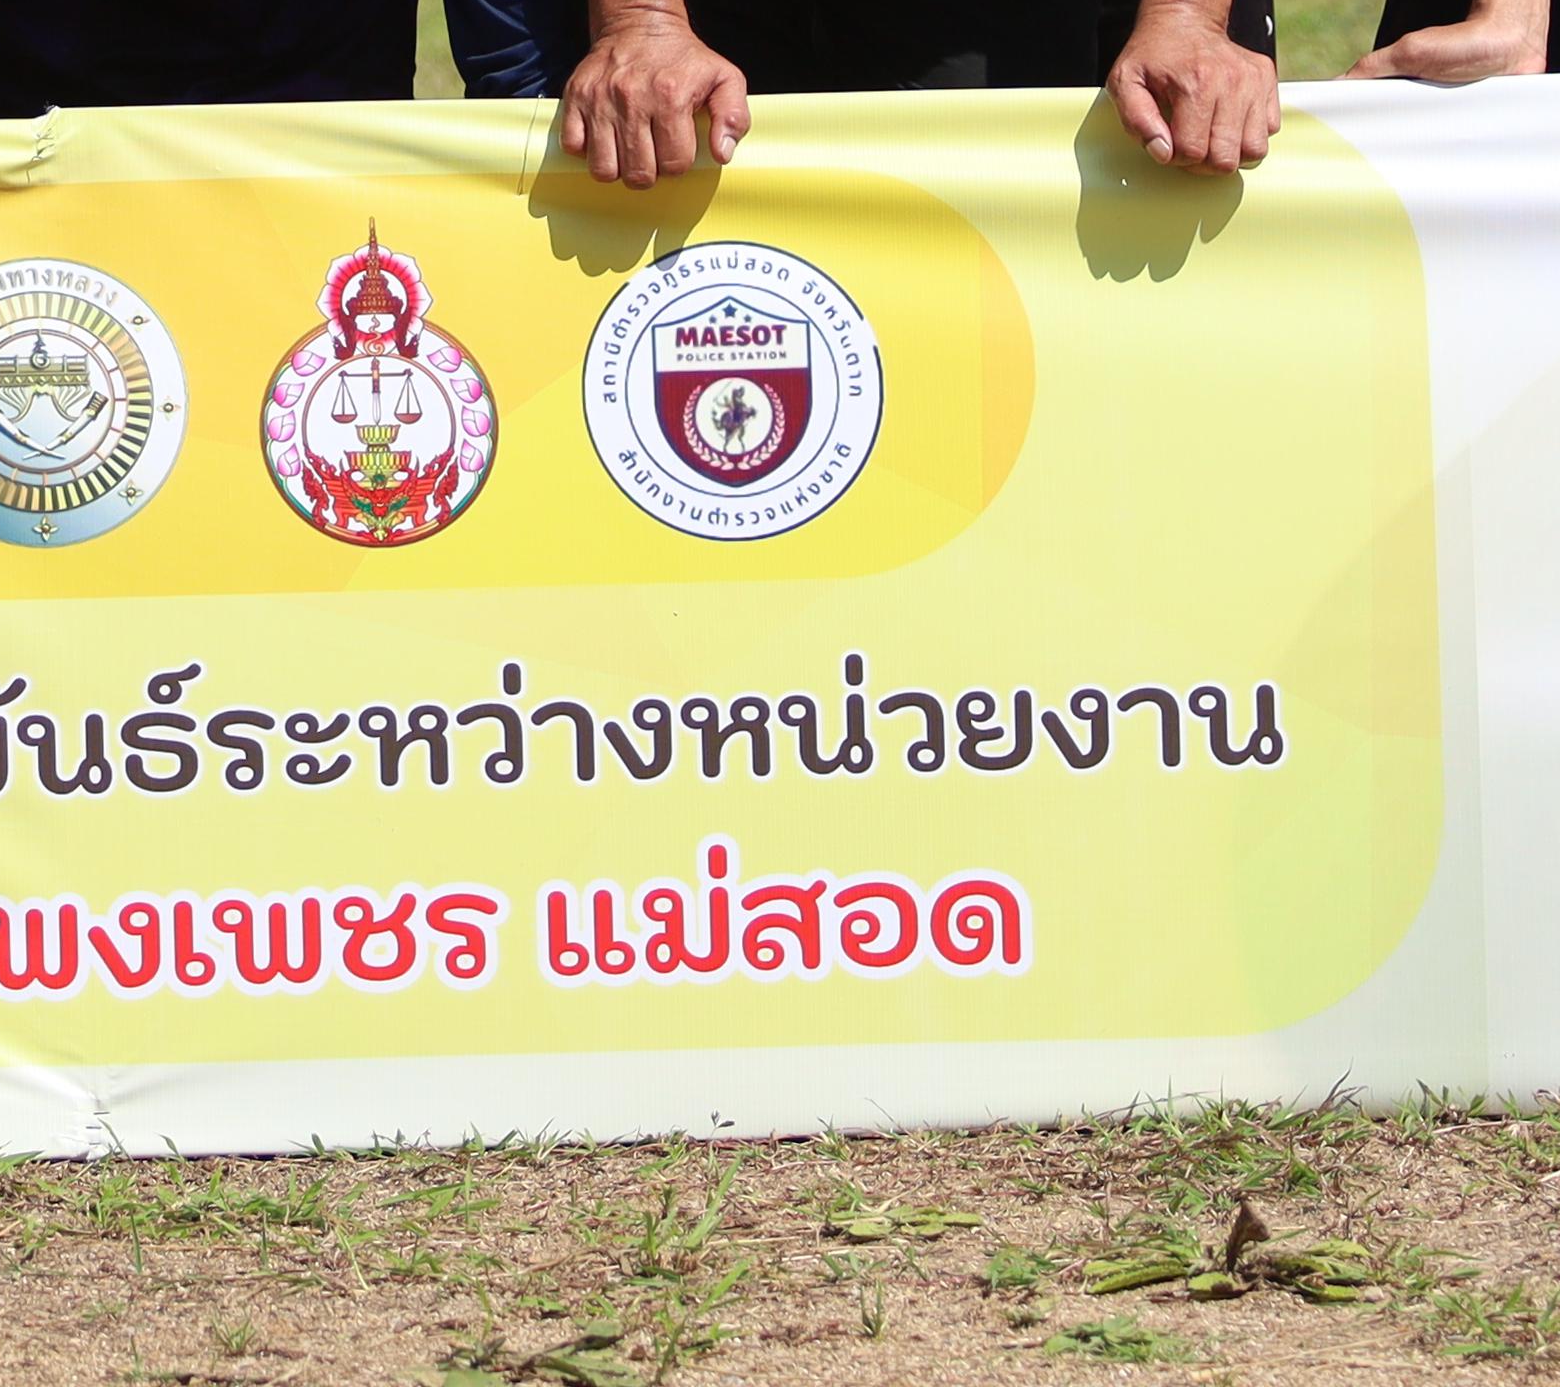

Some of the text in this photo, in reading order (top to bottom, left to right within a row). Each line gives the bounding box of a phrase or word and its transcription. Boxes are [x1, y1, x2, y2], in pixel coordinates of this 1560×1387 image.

[602, 251, 790, 403] สถานีตำรวจภูธรแม่สอด
[675, 325, 787, 349] MAESOT
[676, 350, 787, 362] POLICE STATION
[618, 442, 852, 527] สำนักงานตำรวจแห่งชาติ
[547, 844, 1021, 976] แม่สอด
